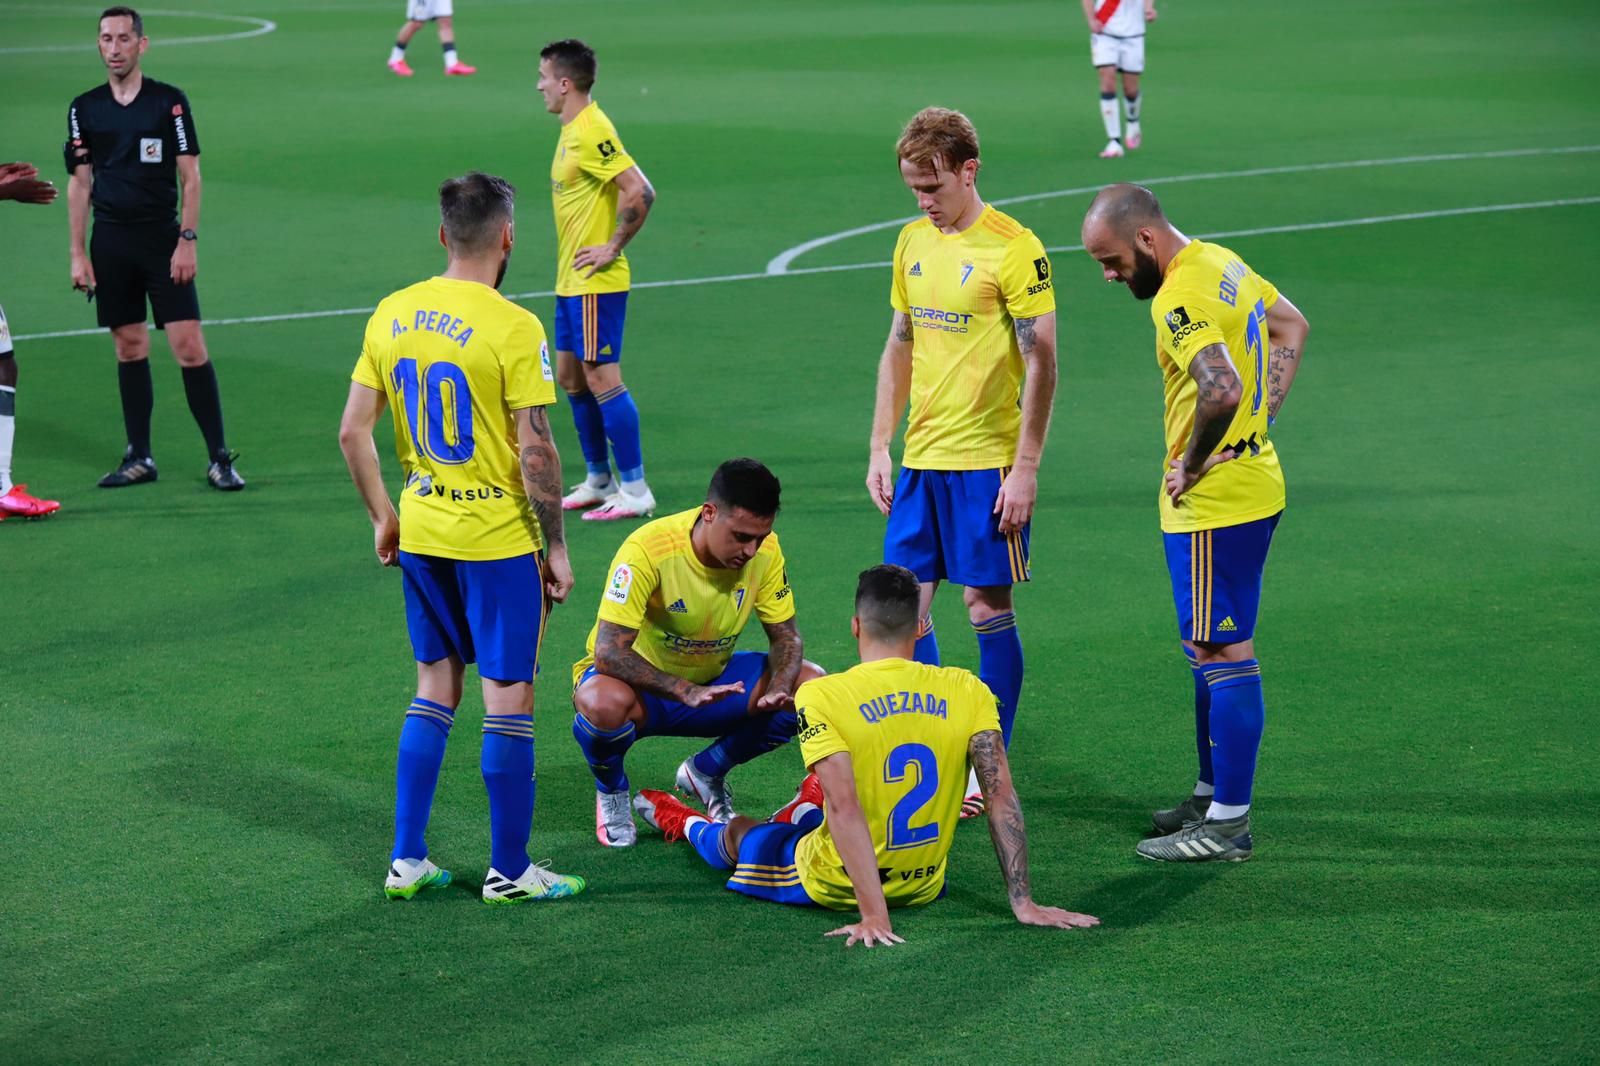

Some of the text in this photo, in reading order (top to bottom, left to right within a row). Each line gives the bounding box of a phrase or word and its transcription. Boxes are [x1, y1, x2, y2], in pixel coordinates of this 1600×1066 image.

[392, 309, 475, 348] A. PEREA
[390, 356, 476, 466] 10
[858, 691, 948, 725] QUEZADA
[883, 742, 940, 852] 2
